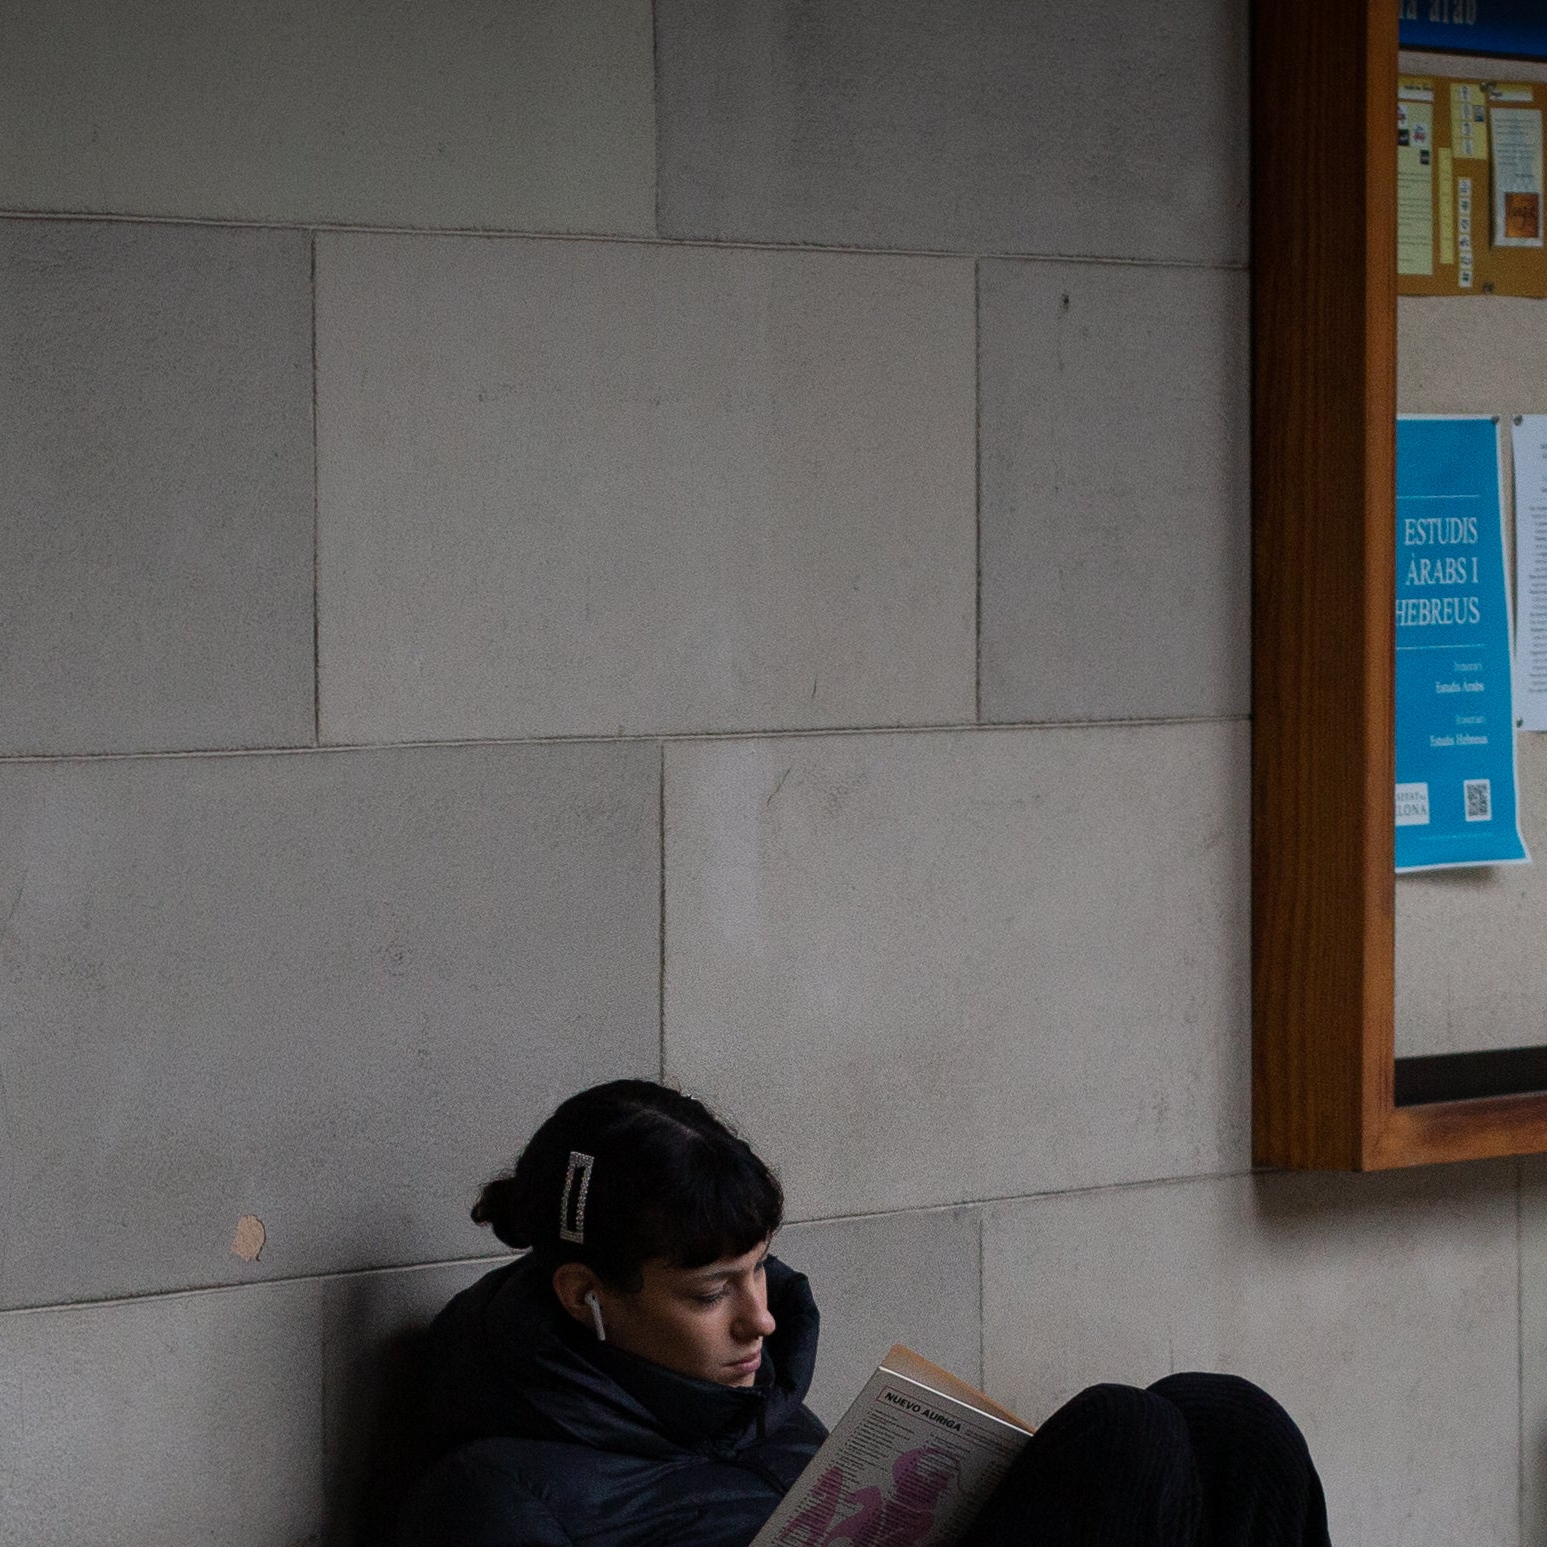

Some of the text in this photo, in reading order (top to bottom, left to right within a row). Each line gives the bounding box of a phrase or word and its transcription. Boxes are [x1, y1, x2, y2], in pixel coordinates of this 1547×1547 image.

[1404, 517, 1478, 546] ESTUDIS
[1405, 553, 1479, 586] ÀRABS I
[1396, 597, 1481, 626] HEBREUS
[885, 1392, 962, 1431] NUEVO AURIGA
